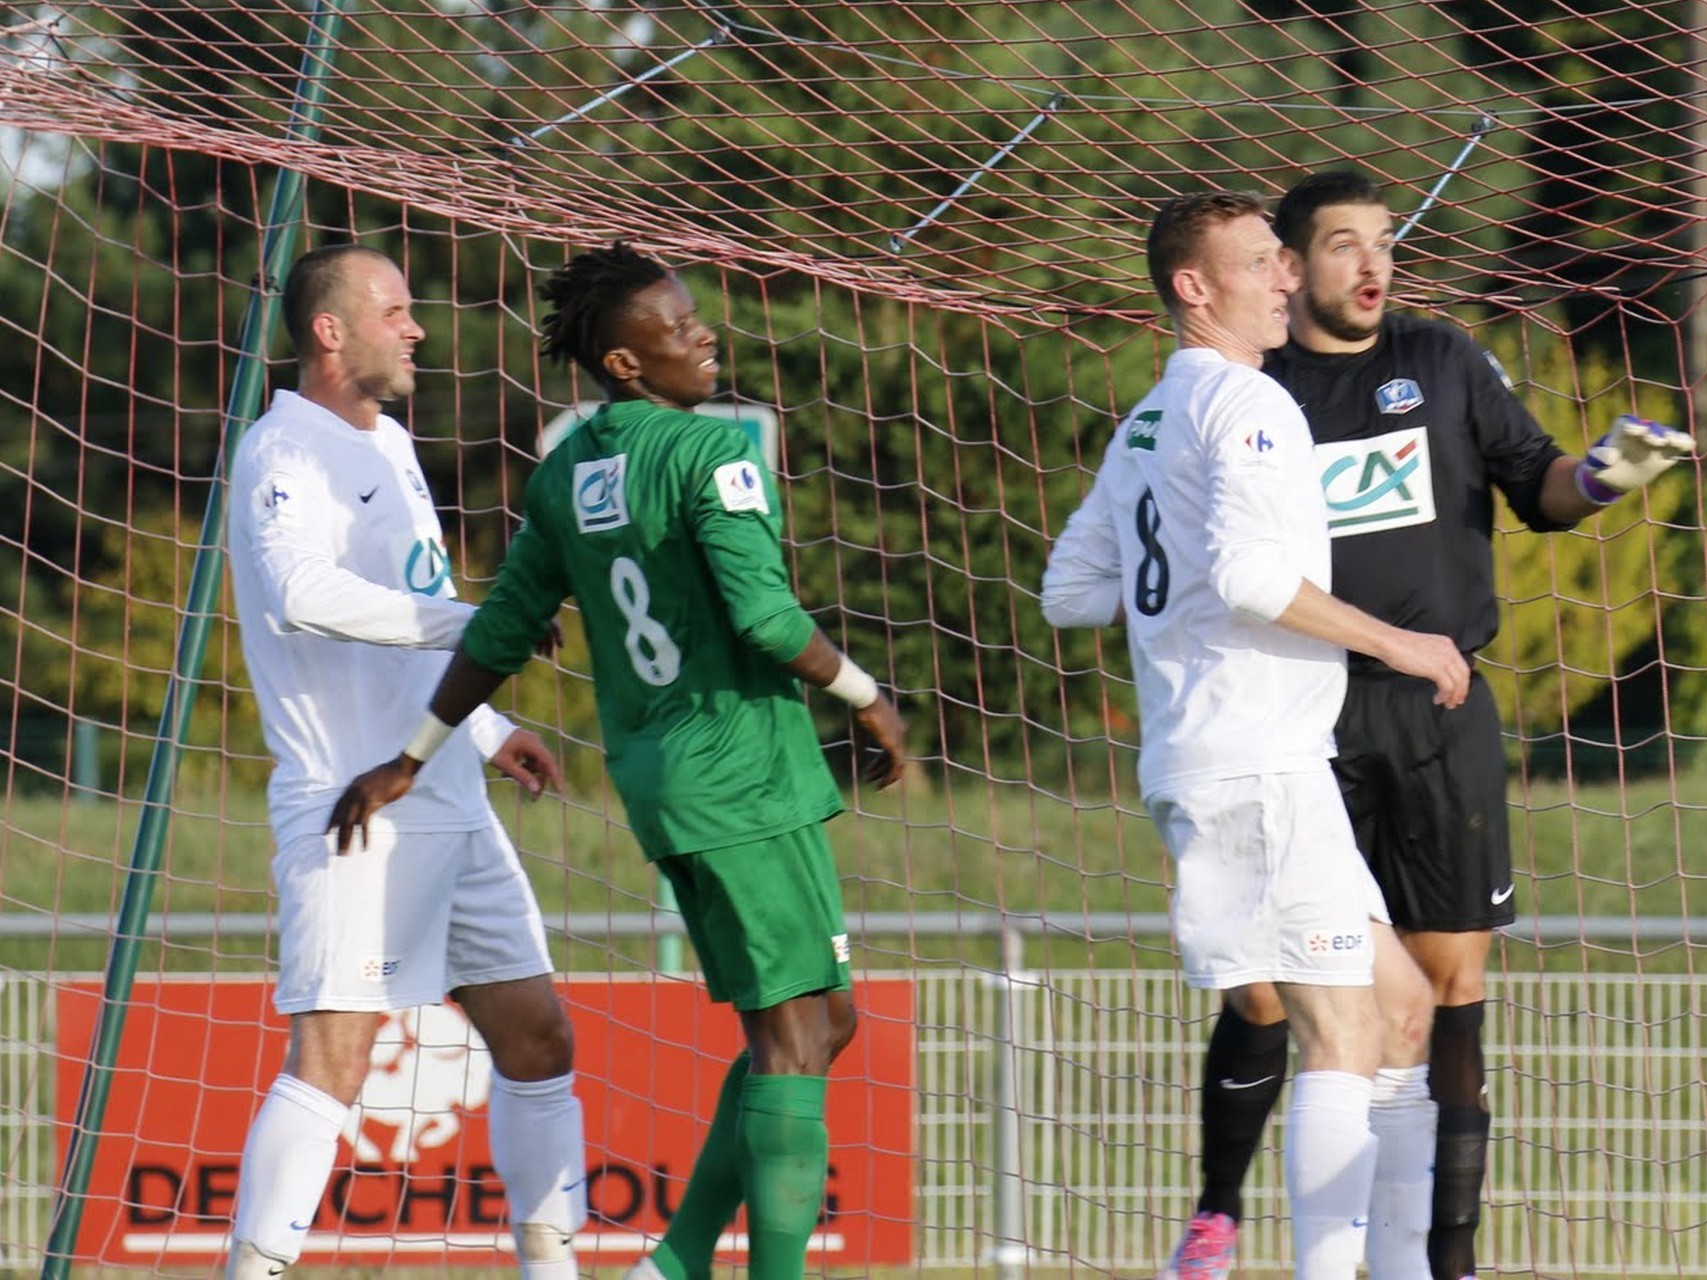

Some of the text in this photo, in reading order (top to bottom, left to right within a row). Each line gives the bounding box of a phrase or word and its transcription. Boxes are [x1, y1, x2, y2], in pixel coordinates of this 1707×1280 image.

[1136, 486, 1170, 616] 8
[610, 556, 681, 687] 8
[131, 1163, 837, 1225] DECHEOU
